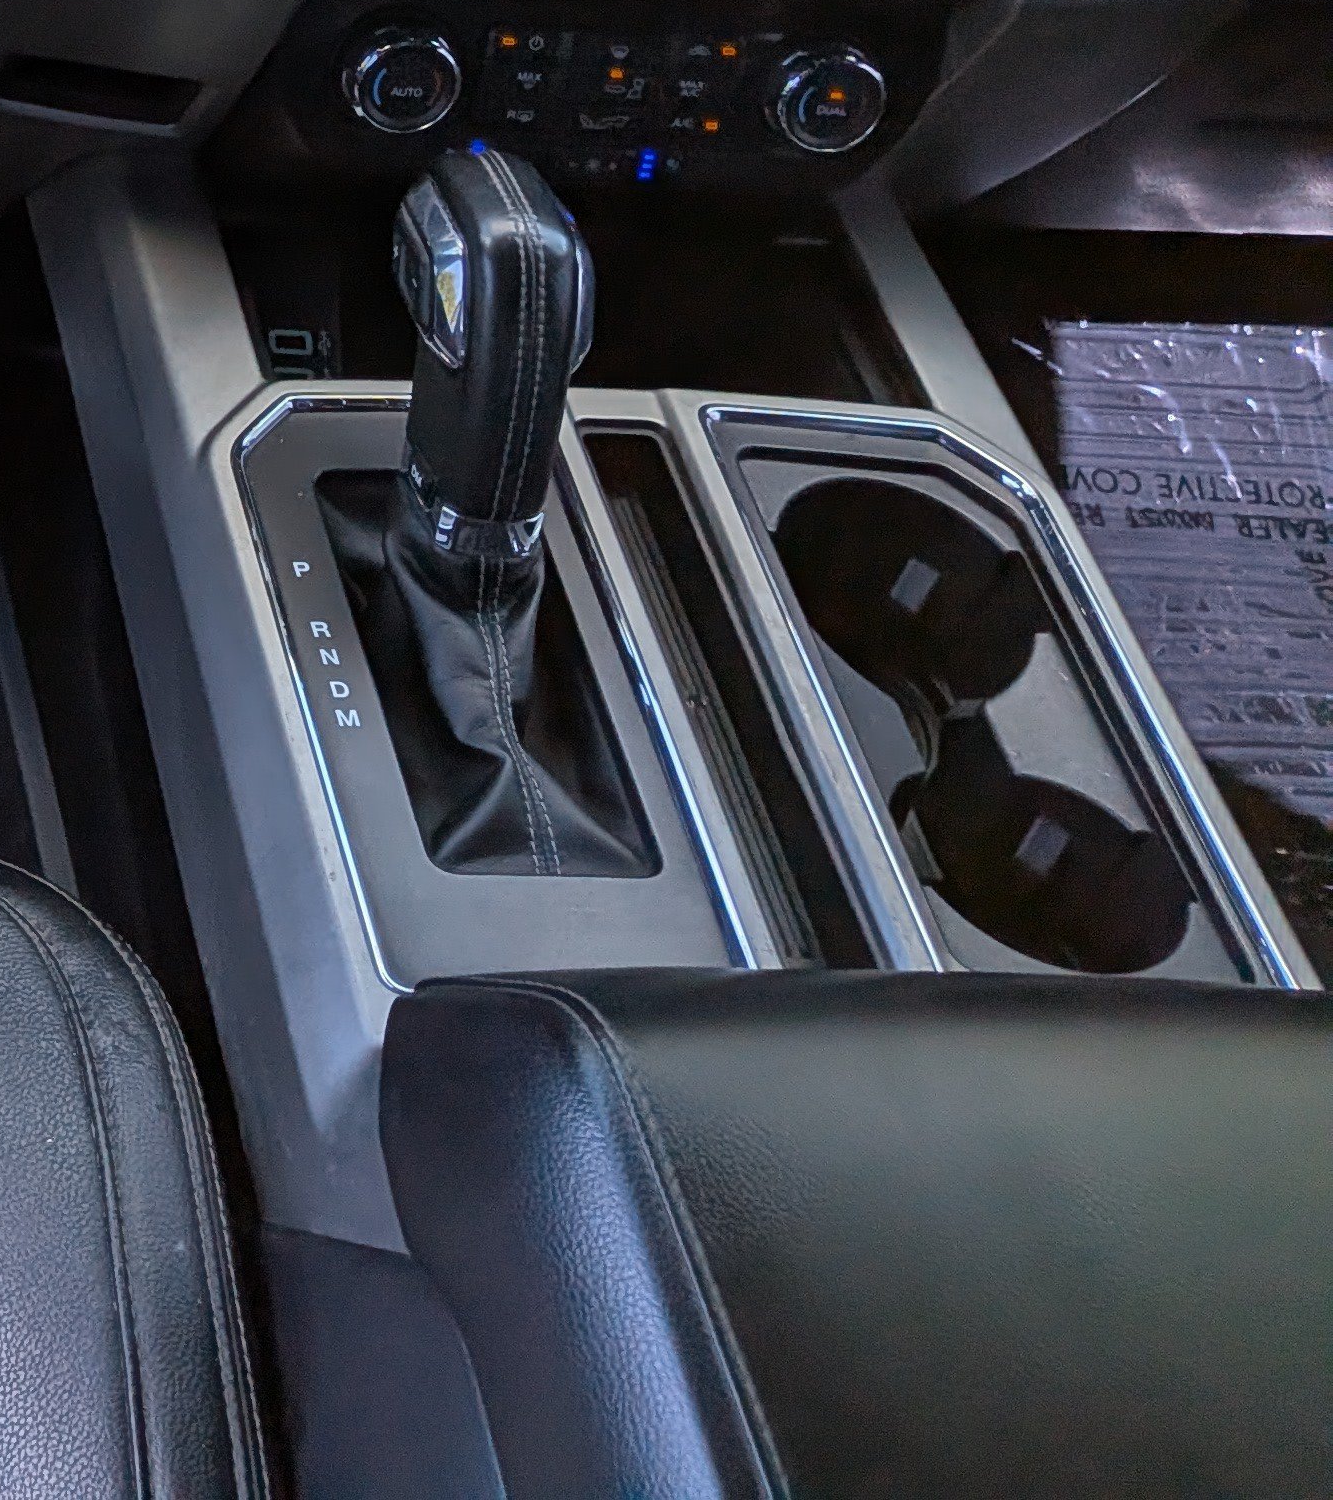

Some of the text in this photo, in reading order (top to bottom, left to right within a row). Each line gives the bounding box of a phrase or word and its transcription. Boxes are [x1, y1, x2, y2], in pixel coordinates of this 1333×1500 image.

[1156, 473, 1333, 510] ROTECTIVE
[1231, 513, 1333, 545] EALER
[293, 561, 311, 578] P
[310, 621, 332, 638] R
[320, 648, 341, 666] N
[329, 680, 350, 699] D
[334, 709, 362, 727] M
